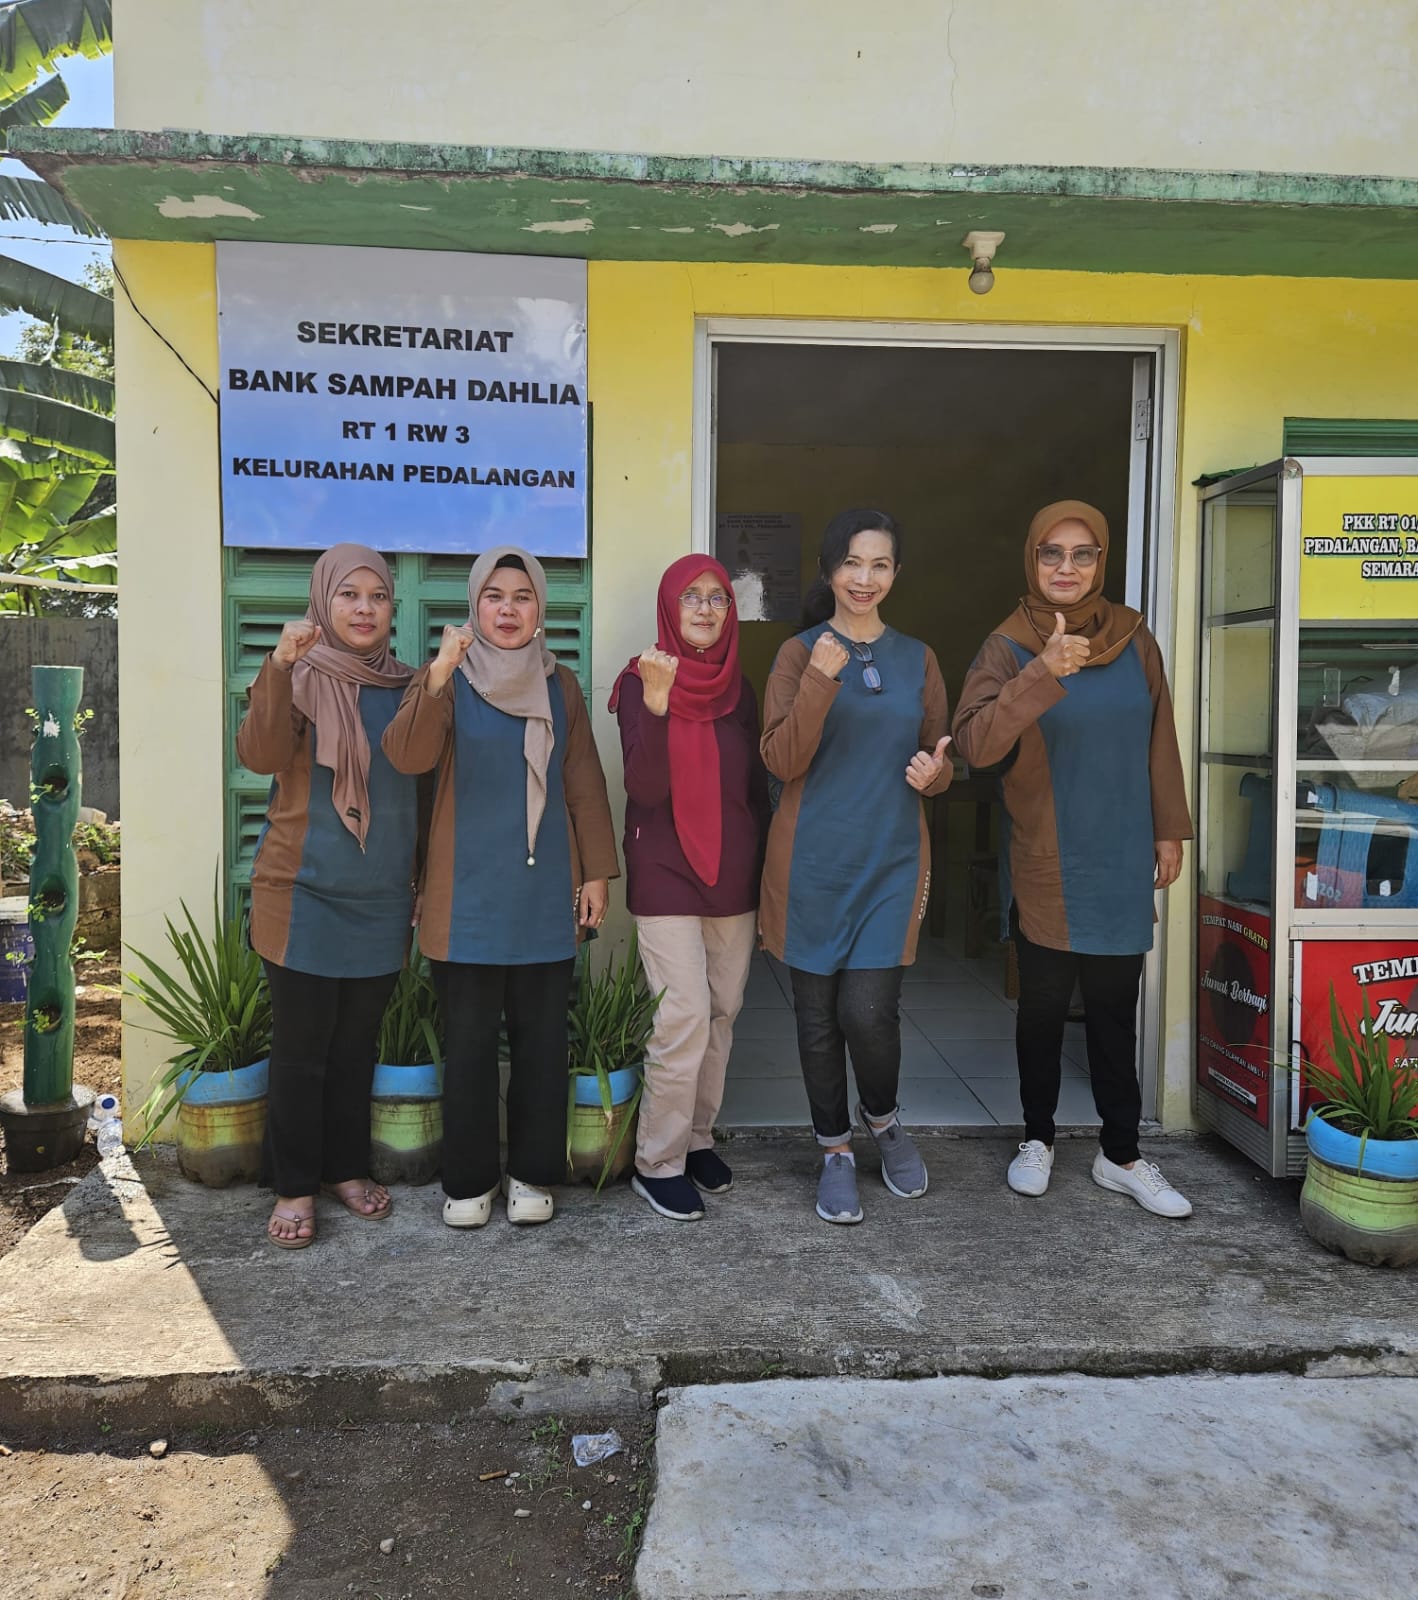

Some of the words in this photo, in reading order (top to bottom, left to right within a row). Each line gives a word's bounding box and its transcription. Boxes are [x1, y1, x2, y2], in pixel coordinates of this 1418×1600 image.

[297, 321, 514, 353] SEKRETARIAT
[228, 368, 318, 394] BANK
[327, 373, 456, 401] SAMPAH
[467, 379, 581, 406] DAHLIA
[342, 420, 376, 440] RT
[384, 422, 396, 441] 1
[407, 423, 448, 443] RW
[455, 425, 470, 444] 3
[232, 457, 394, 482] KELURAHAN
[403, 464, 575, 489] PEDALANGAN
[1343, 514, 1375, 530] PKK
[1378, 515, 1398, 530] RT
[1304, 538, 1402, 556] PEDALANGAN,
[1406, 538, 1418, 554] B
[1202, 915, 1226, 927] TEMPAT
[1228, 919, 1242, 933] NASI
[1243, 927, 1268, 950] GRATIS
[1230, 981, 1267, 1014] Berbagi
